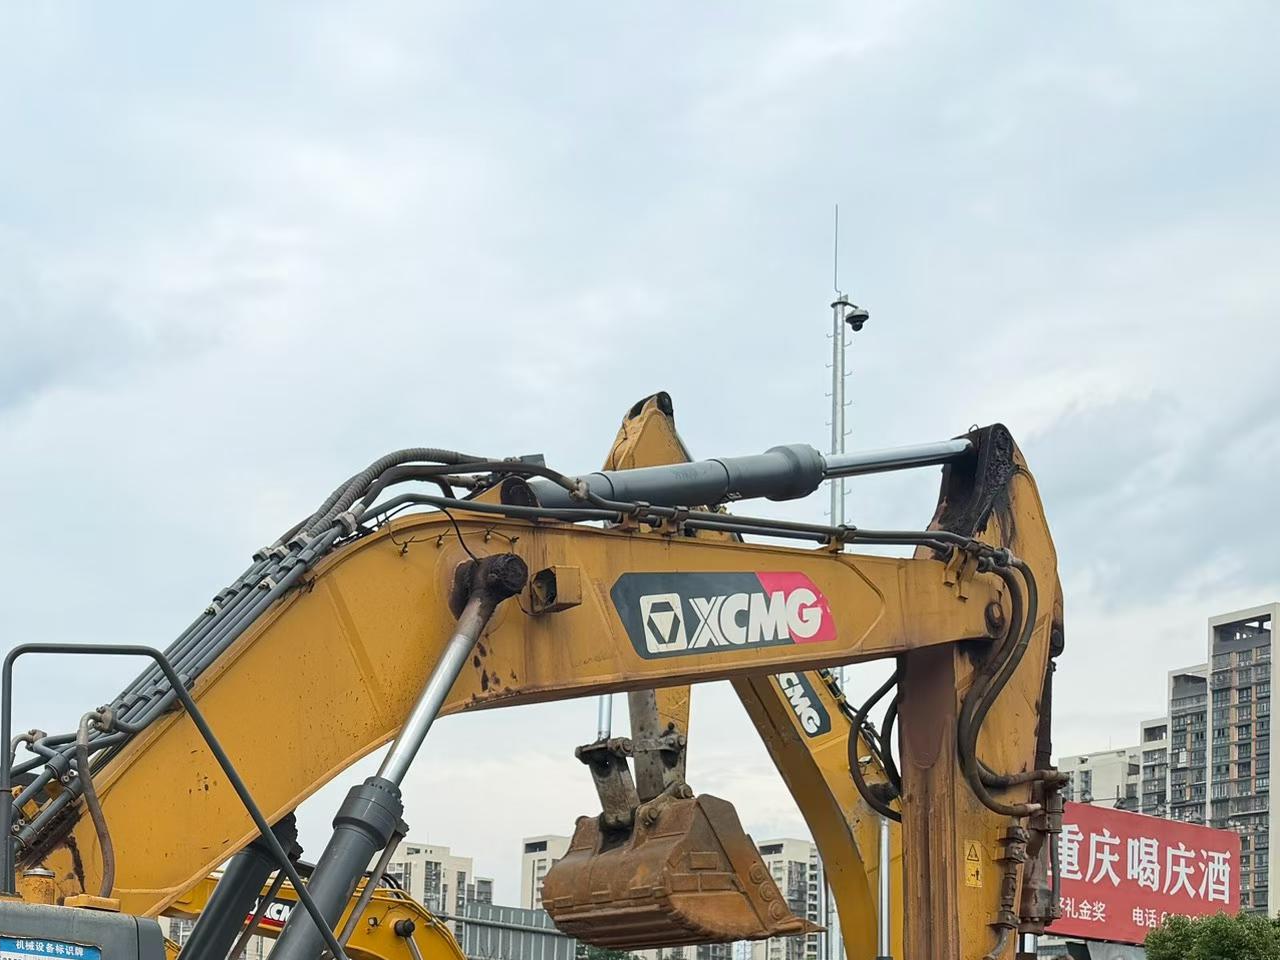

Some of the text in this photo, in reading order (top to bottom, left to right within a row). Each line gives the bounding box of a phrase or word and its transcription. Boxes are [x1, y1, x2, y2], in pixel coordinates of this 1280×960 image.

[687, 588, 822, 649] XCMG
[15, 939, 84, 957] 机械设备标识牌
